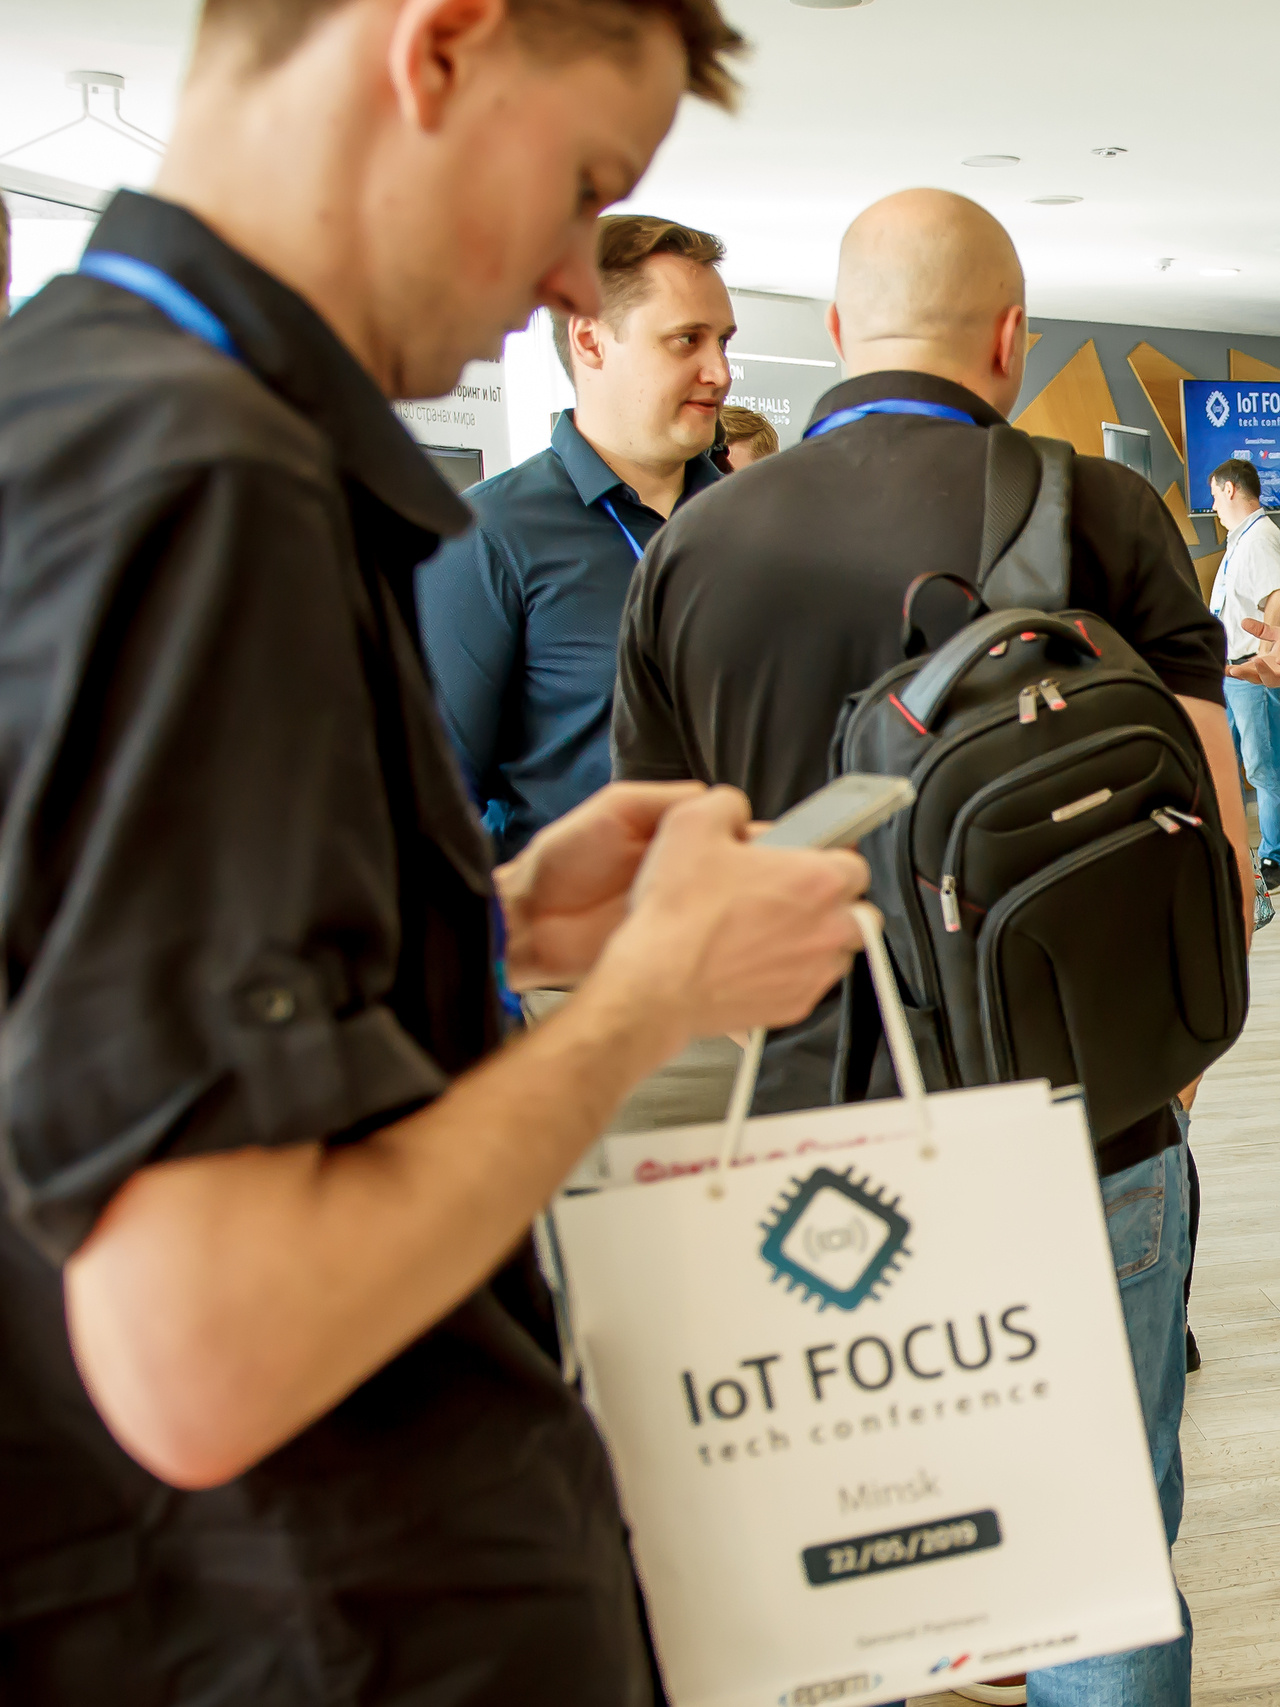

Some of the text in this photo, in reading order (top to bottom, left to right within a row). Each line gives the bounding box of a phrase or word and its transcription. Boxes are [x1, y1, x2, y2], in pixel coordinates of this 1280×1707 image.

[490, 385, 502, 402] IoT
[758, 397, 791, 414] HALLS
[1236, 392, 1259, 413] IoT
[416, 405, 452, 426] странах
[453, 409, 476, 429] мира
[1238, 417, 1259, 427] tech
[682, 1303, 1040, 1427] IoT FOCUS
[697, 1380, 1050, 1467] tech conference
[837, 1469, 942, 1515] Minsk
[824, 1519, 980, 1576] 22/05/2019
